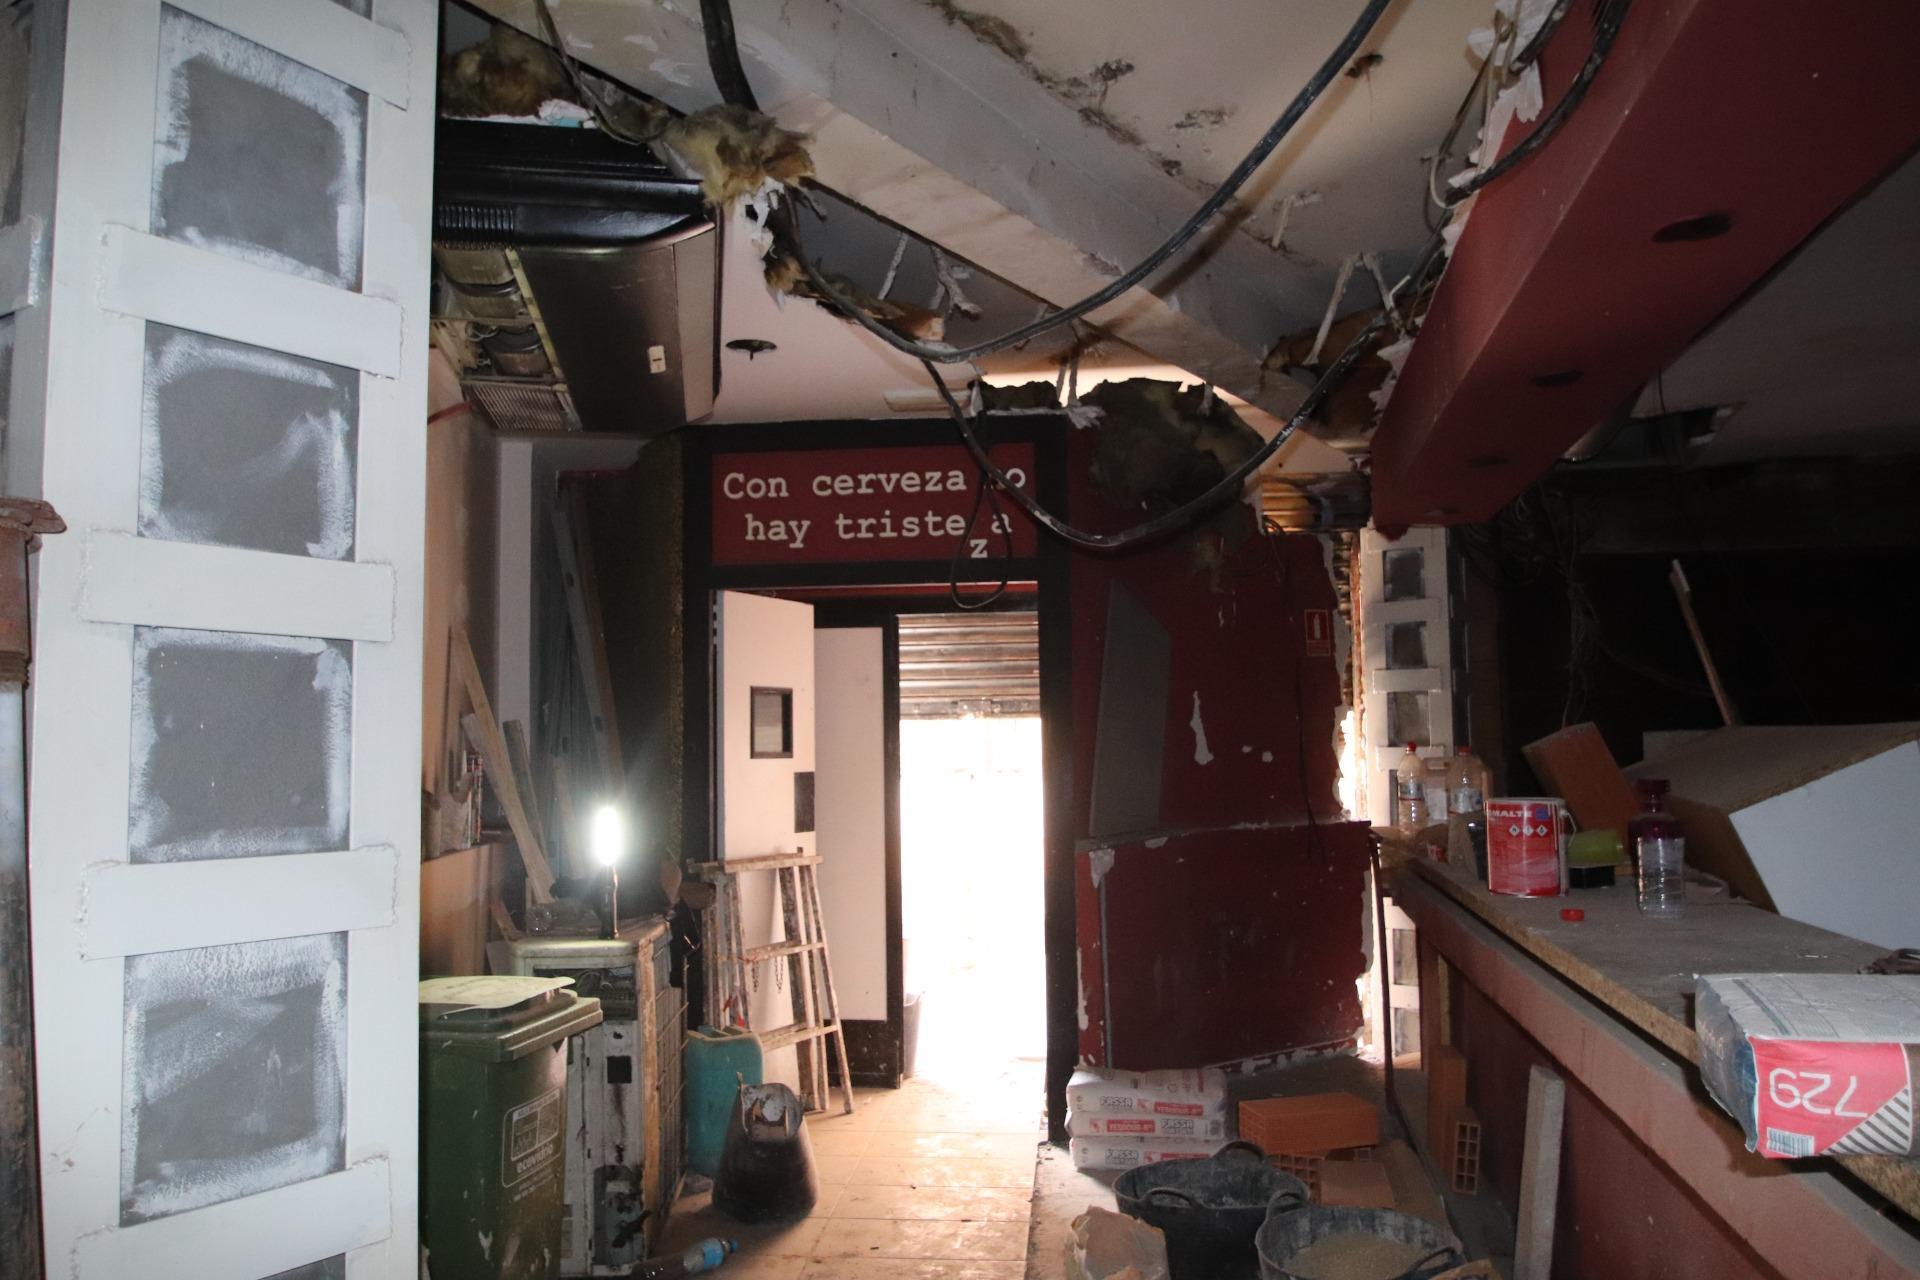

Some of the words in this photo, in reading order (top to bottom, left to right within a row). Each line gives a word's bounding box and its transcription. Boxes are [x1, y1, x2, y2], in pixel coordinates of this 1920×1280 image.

[723, 472, 789, 499] Con
[812, 469, 967, 497] cerveza
[745, 513, 811, 549] hay
[1769, 1067, 1868, 1118] 729
